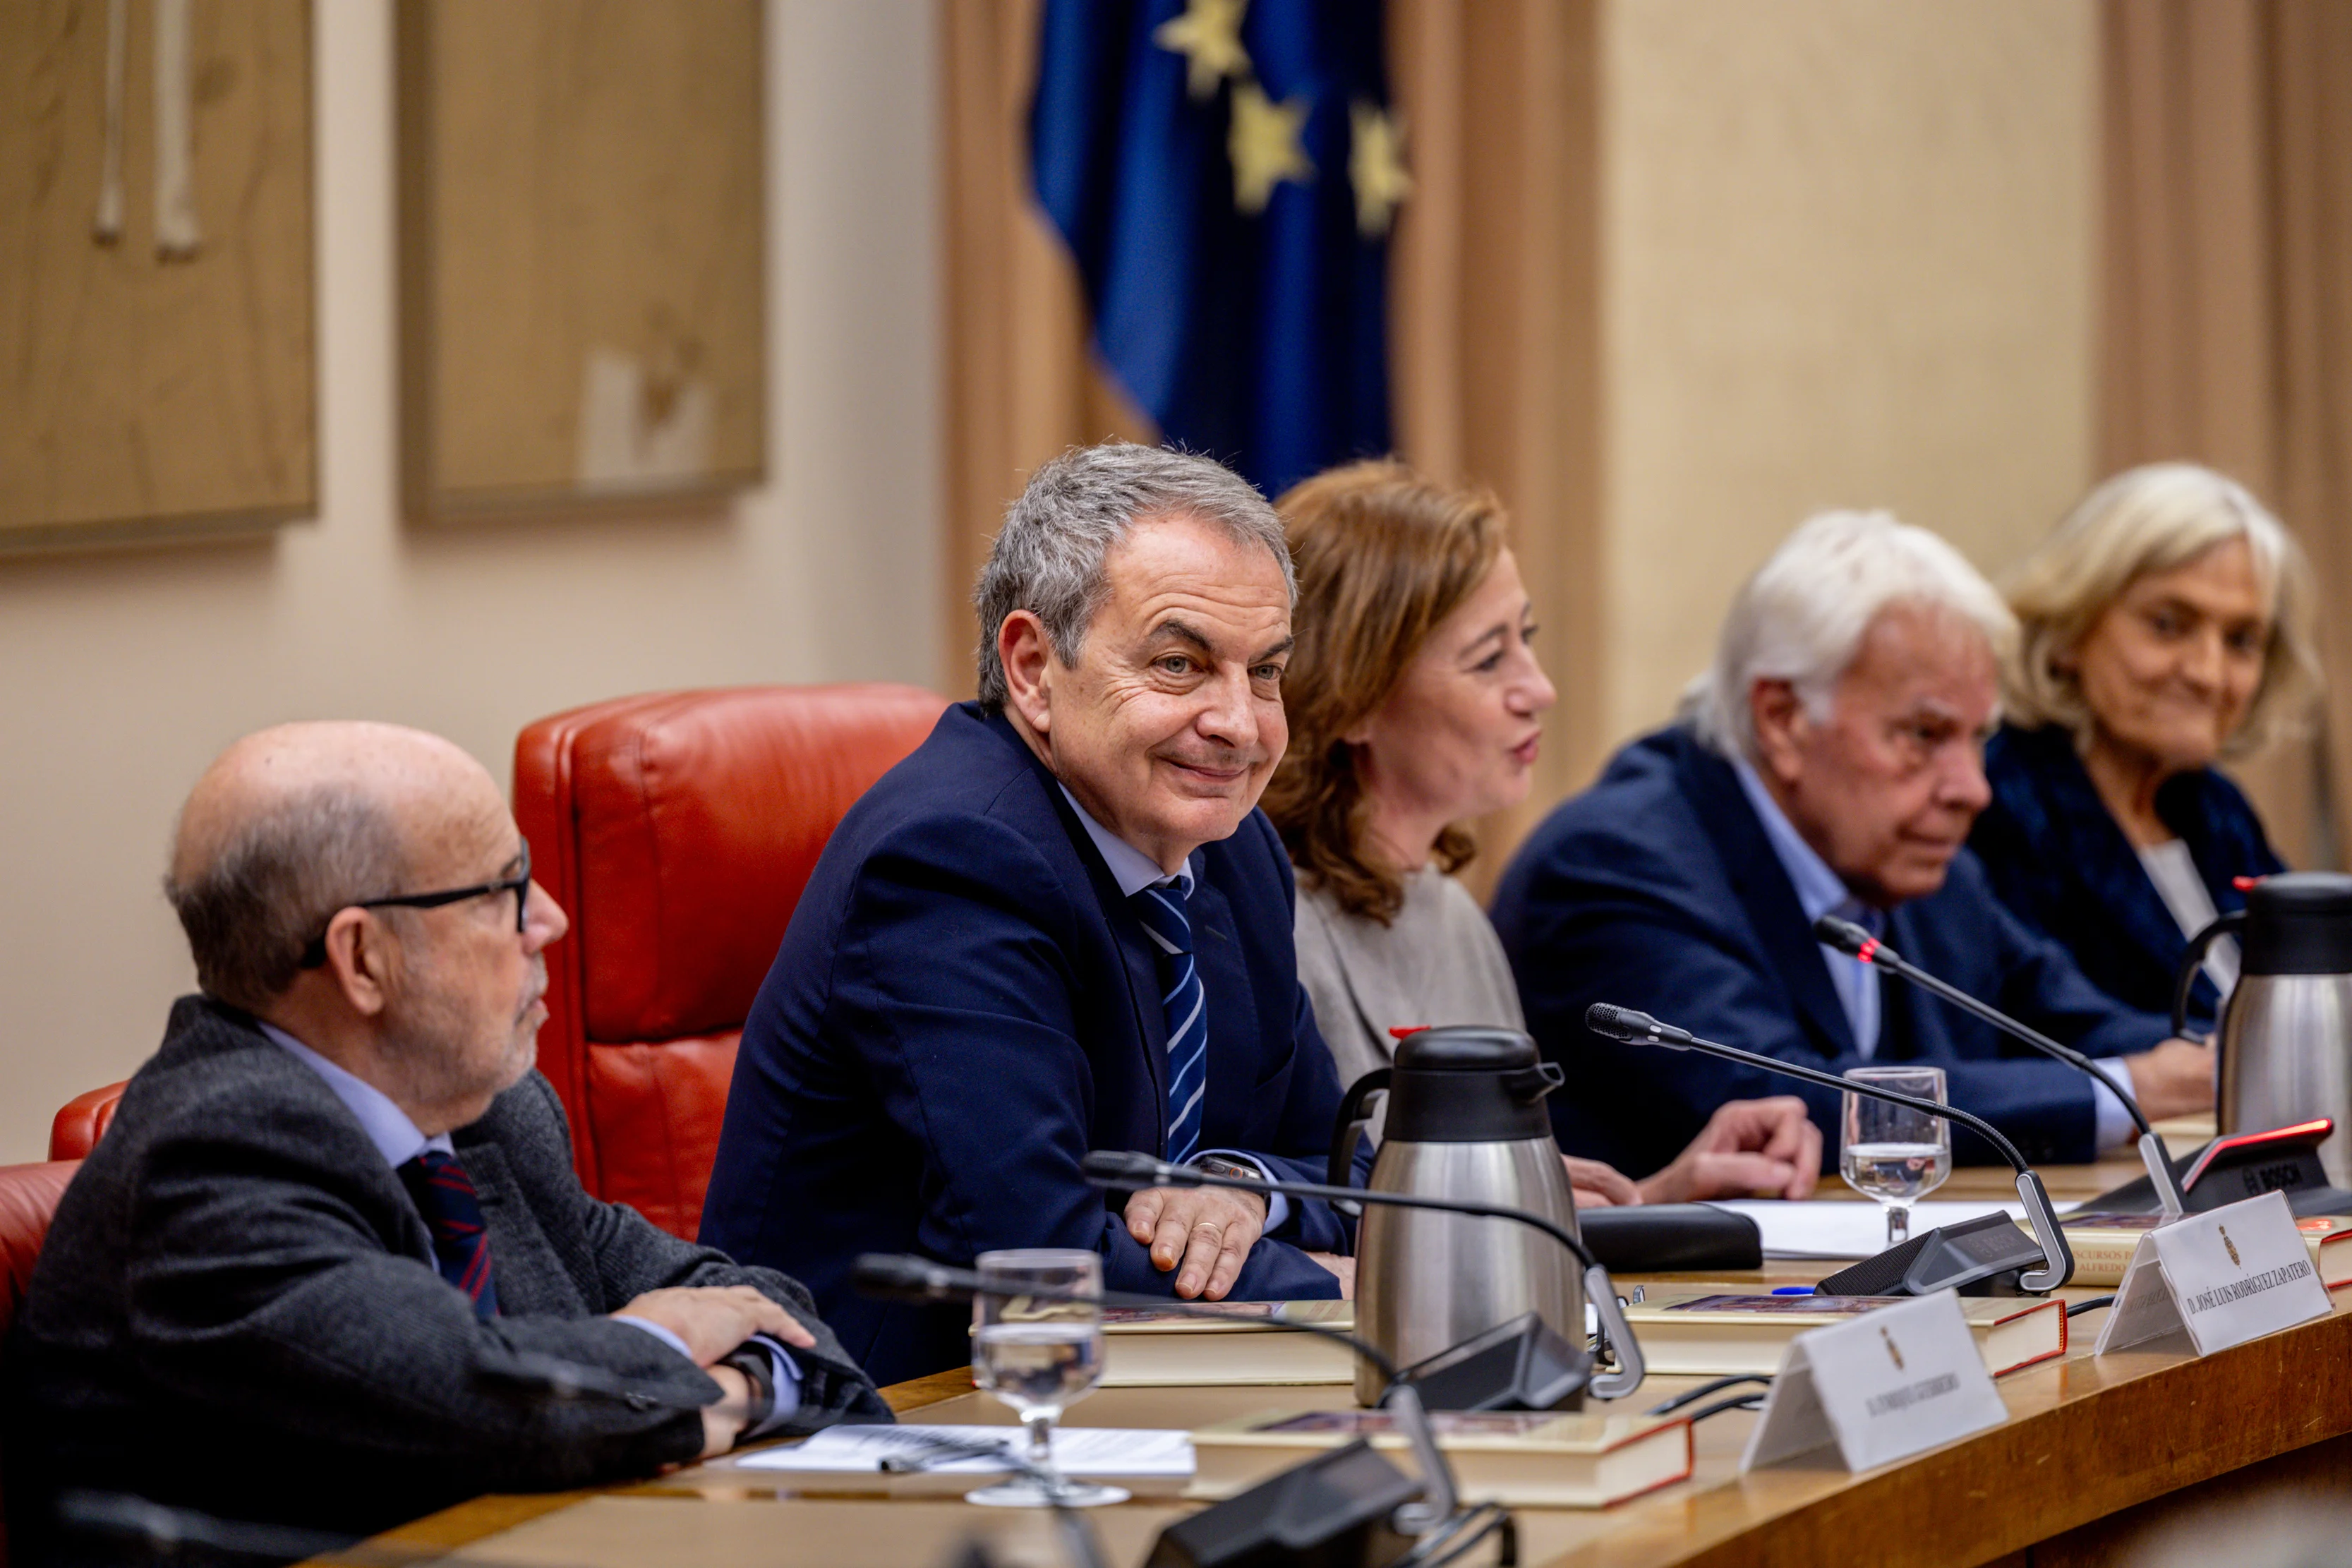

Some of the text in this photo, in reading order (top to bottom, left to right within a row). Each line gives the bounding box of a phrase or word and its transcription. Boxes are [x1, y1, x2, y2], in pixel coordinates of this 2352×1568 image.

[2073, 1250, 2122, 1260] ISCURSOS
[2079, 1262, 2127, 1272] ALFREDO
[2196, 1286, 2217, 1312] JOSÉ
[2213, 1285, 2233, 1306] LUIS
[2229, 1273, 2275, 1300] RODRÍGUEZ
[2271, 1260, 2312, 1286] ZAPATERO
